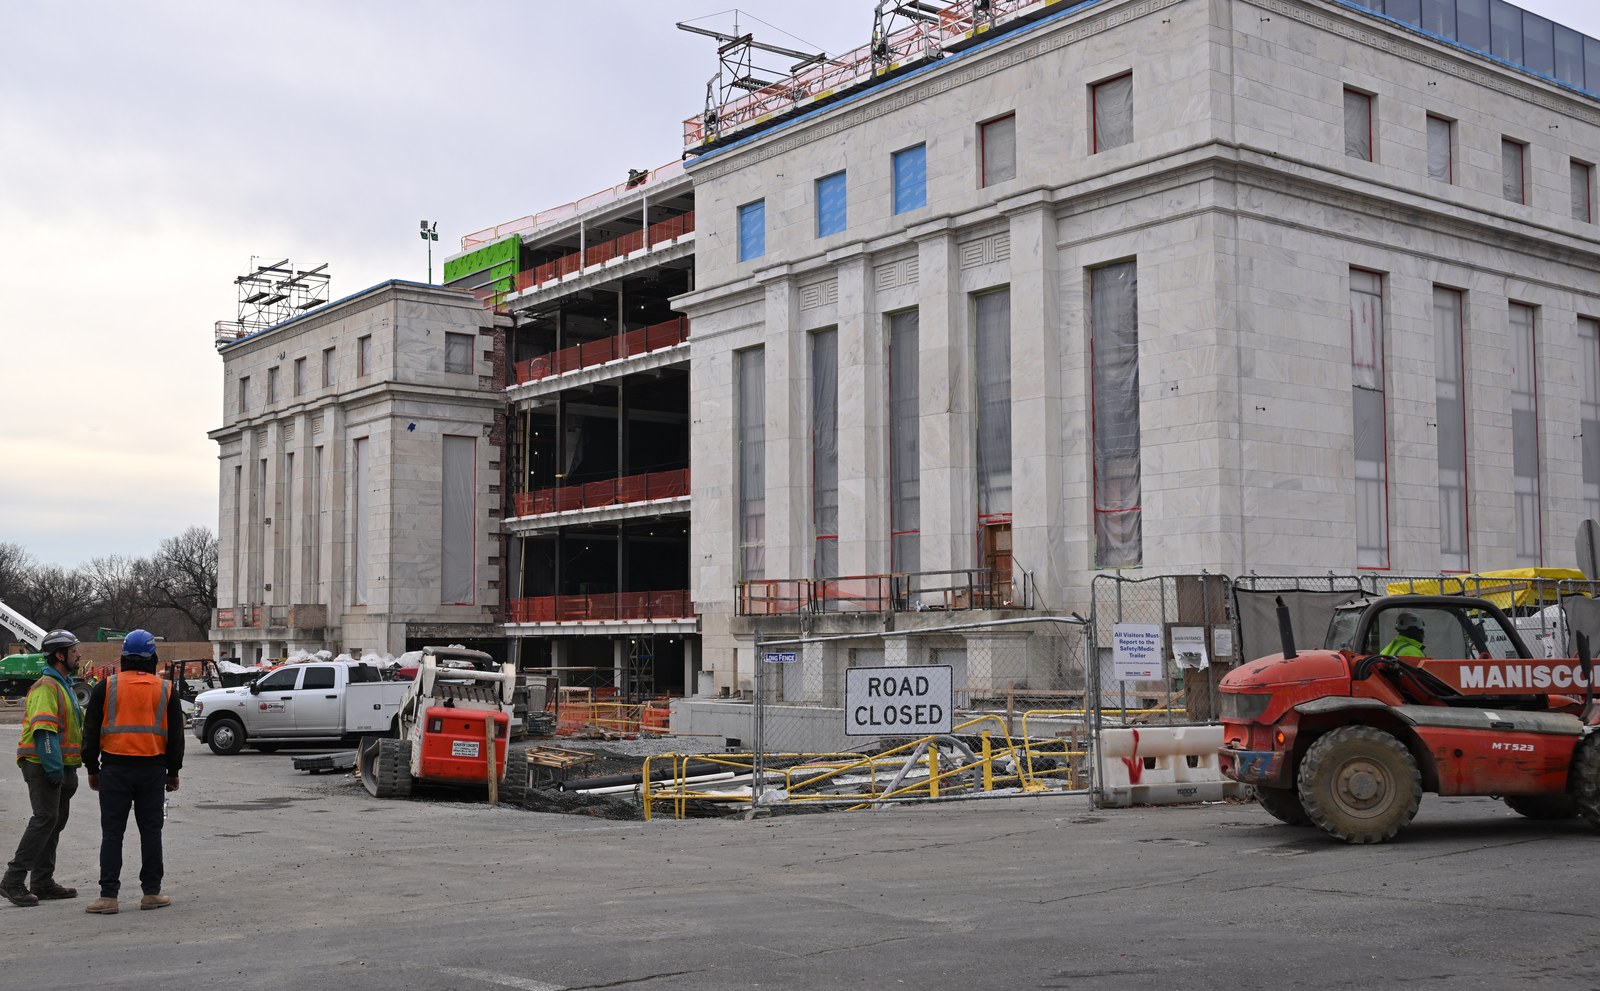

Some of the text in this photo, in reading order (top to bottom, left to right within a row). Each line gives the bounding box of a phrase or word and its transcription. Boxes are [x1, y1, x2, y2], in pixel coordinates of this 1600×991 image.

[9, 619, 24, 632] ULTRA
[23, 628, 38, 641] BOOM
[868, 676, 929, 697] ROAD
[855, 704, 943, 726] CLOSED
[1491, 742, 1535, 752] MT523
